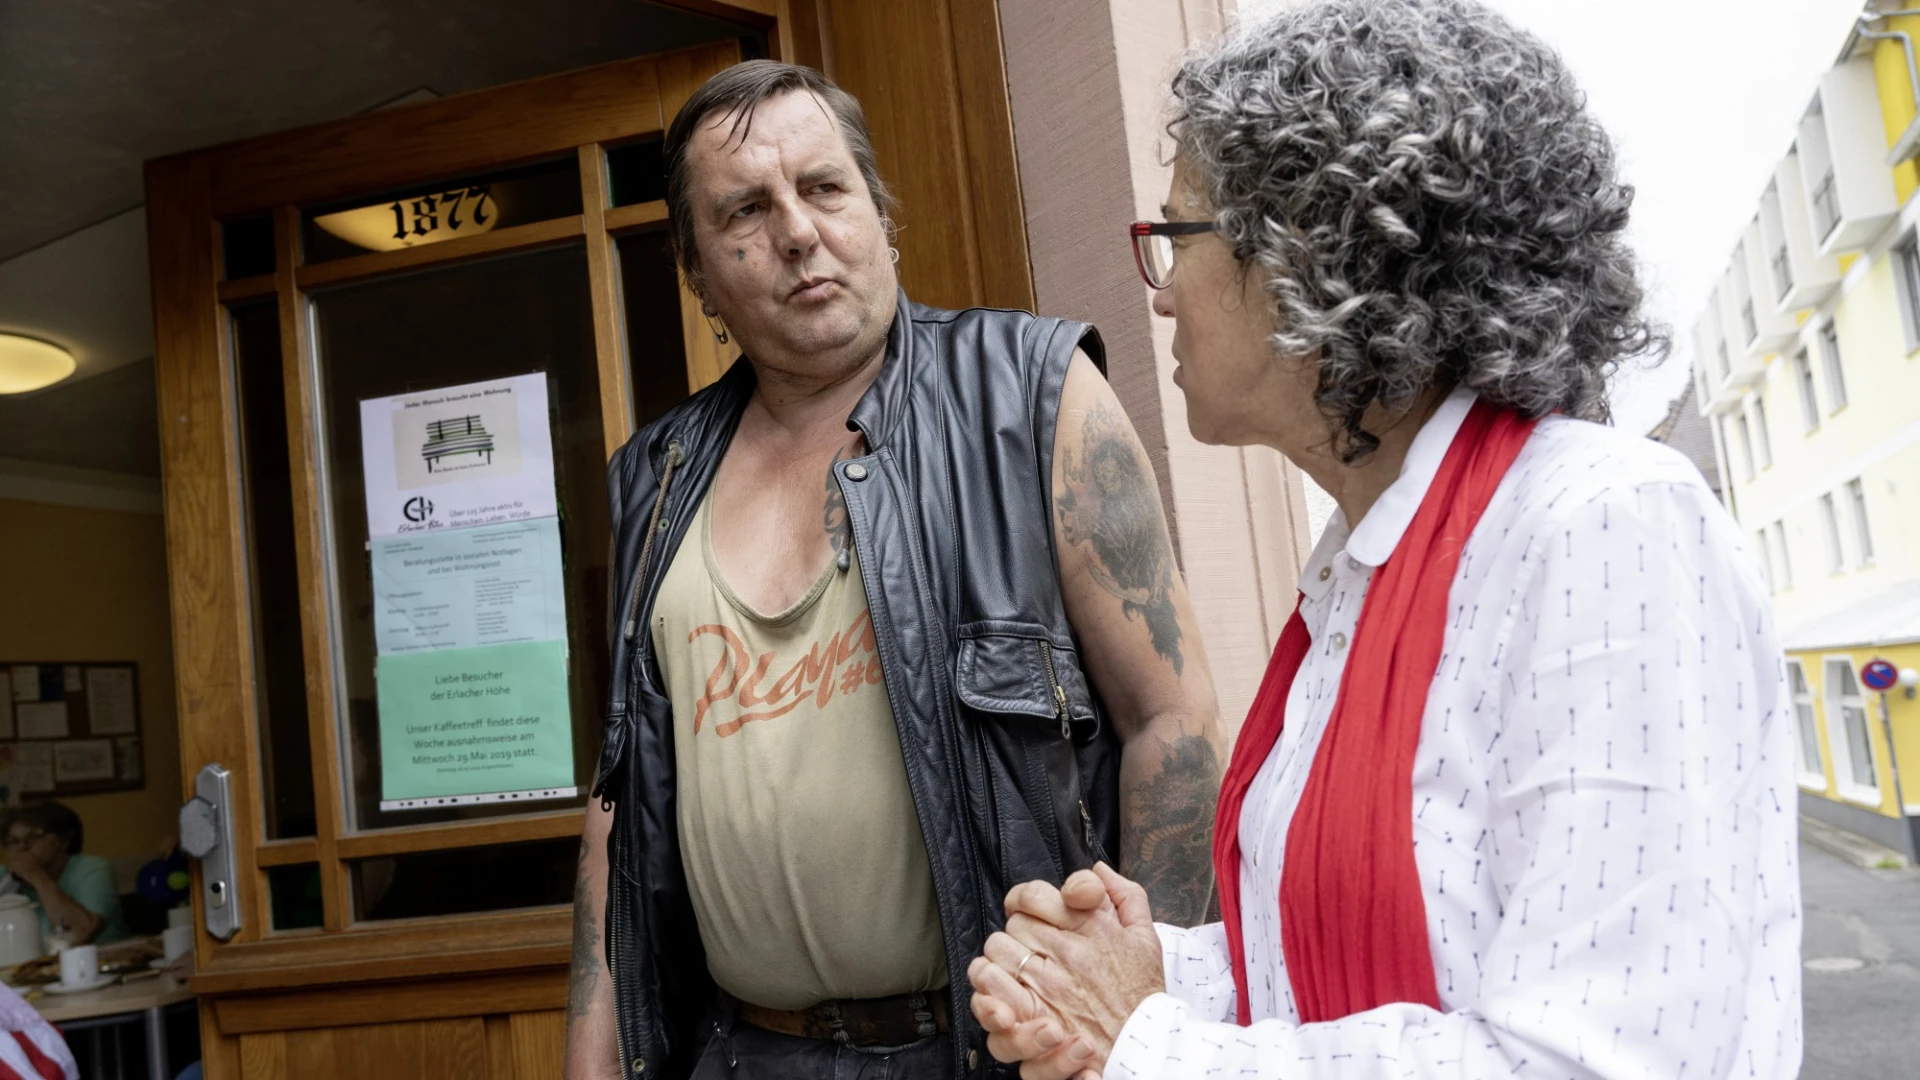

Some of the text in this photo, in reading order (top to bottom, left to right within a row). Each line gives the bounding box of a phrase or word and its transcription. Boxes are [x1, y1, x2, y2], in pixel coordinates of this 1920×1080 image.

[390, 185, 490, 240] 1877
[434, 670, 504, 685] Liebe Besucher
[430, 685, 511, 701] der Erlacher Höhe
[405, 715, 541, 734] Unser Kaffeetreff findet diese
[413, 732, 536, 750] Woche ausnahmsweise am
[412, 752, 456, 765] Mittwoch
[489, 750, 513, 761] 2019
